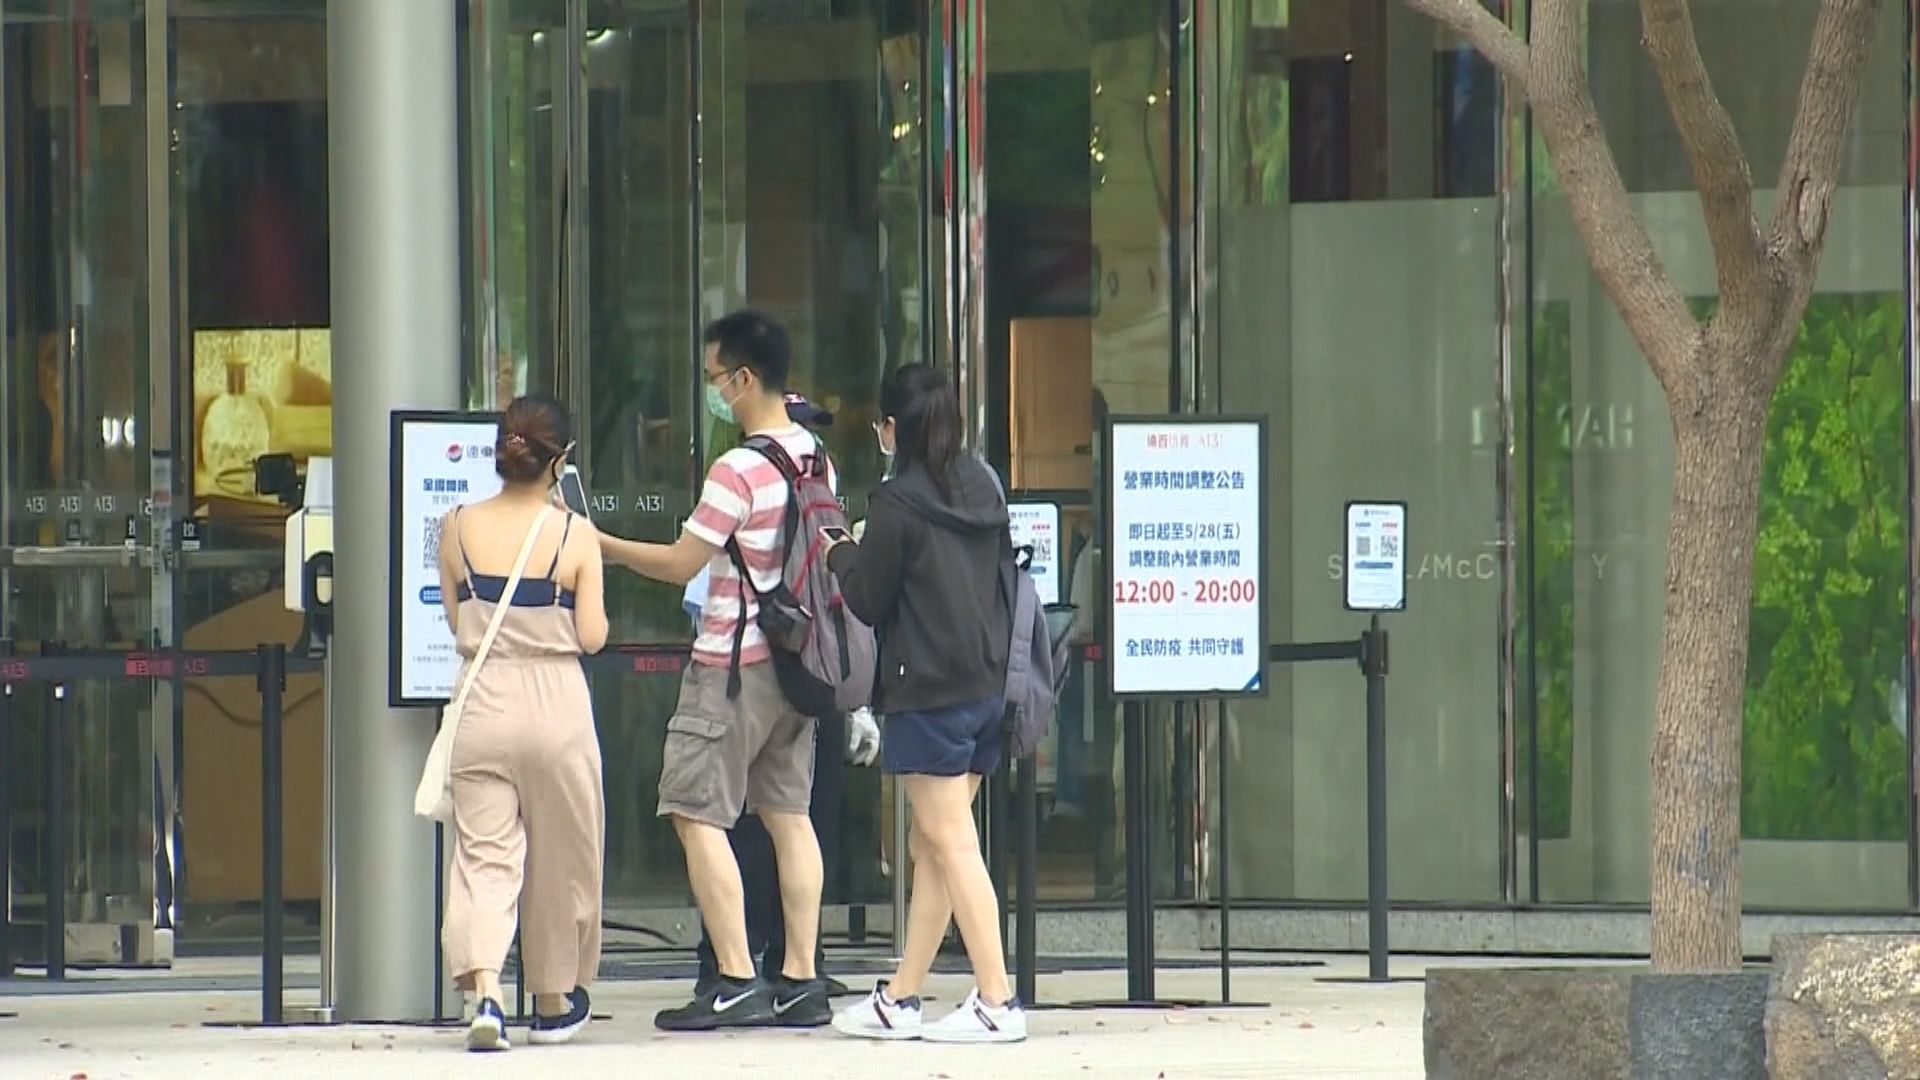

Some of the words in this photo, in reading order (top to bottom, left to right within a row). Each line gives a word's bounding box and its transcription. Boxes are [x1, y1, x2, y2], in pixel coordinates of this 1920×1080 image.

[1123, 470, 1245, 490] 營業時間調整公告
[1128, 522, 1241, 542] 即日起至5/28(五)
[1129, 549, 1240, 568] 調整館內營業時間
[1115, 580, 1174, 603] 12:00
[1195, 580, 1255, 603] 20:00
[1126, 638, 1182, 657] 全民防疫
[1188, 637, 1244, 656] 共同守護
